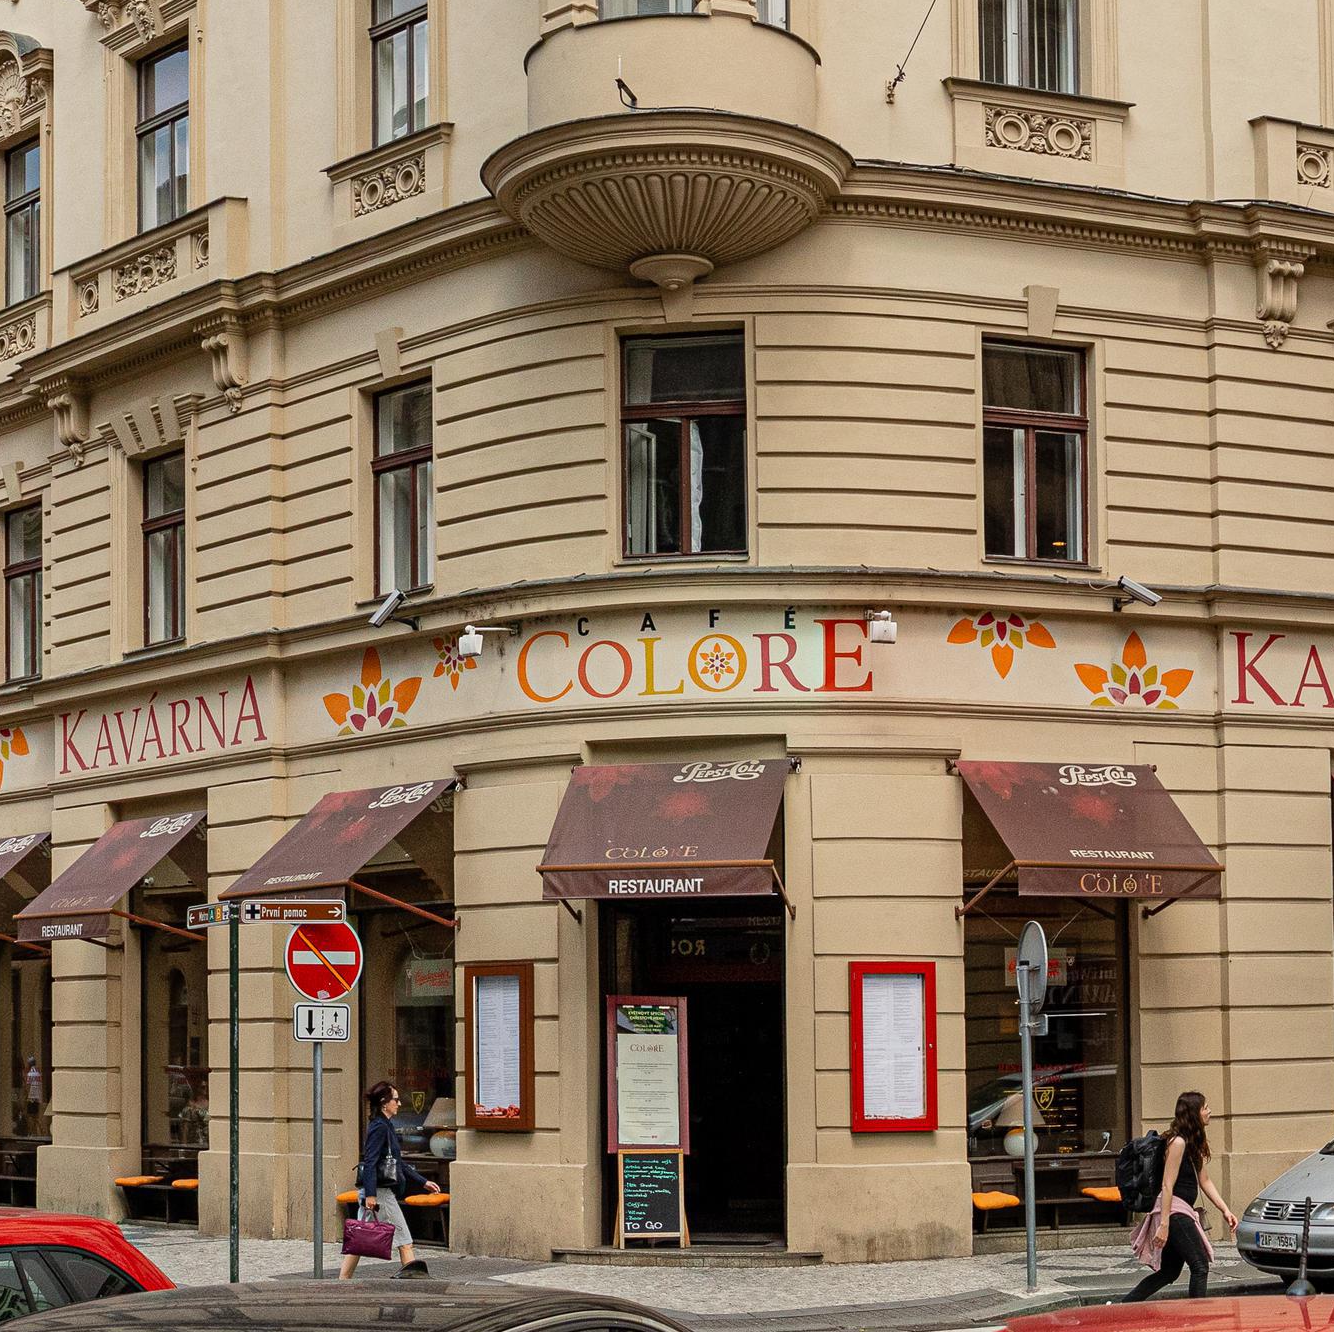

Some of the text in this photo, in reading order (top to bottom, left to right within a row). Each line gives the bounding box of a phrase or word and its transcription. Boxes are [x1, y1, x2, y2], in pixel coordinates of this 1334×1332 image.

[576, 606, 796, 636] CAFÉ
[517, 619, 873, 703] COLORE
[59, 675, 268, 775] KAVÁRNA
[1070, 849, 1155, 860] RESTAURANT
[263, 872, 323, 886] RESTAURANT
[608, 878, 704, 894] RESTAURANT
[210, 909, 215, 920] A
[217, 907, 222, 919] B
[262, 906, 307, 920] První pomoc
[41, 923, 83, 938] RESTAURANT
[625, 1221, 663, 1230] TO GO
[1277, 1236, 1293, 1247] 1594
